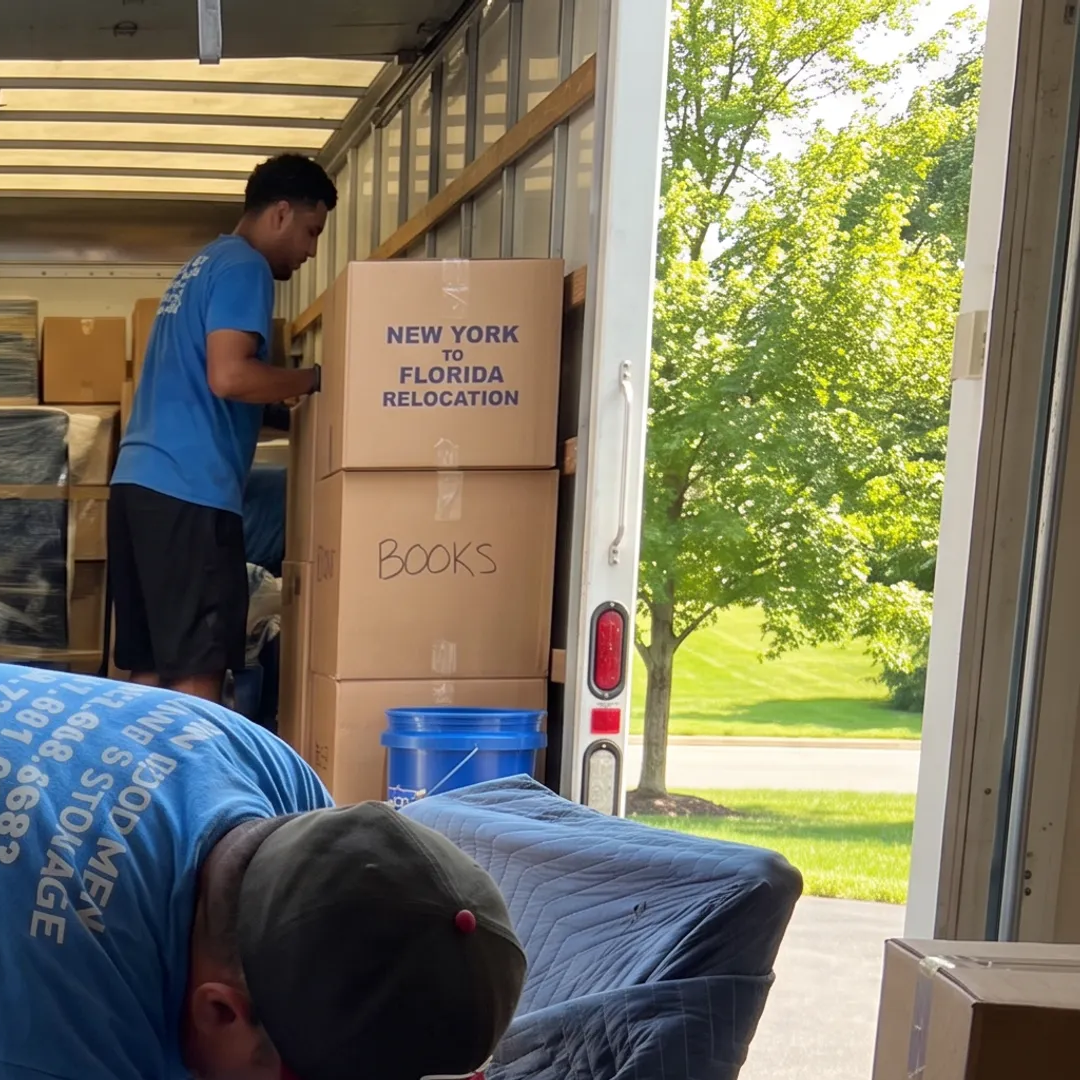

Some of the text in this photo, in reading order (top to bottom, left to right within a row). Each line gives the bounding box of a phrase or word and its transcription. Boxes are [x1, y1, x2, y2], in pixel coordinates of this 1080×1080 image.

[386, 325, 520, 344] NEW YORK
[442, 349, 464, 362] TO
[399, 366, 505, 384] FLORIDA
[382, 390, 520, 407] RELOCATION
[378, 538, 498, 580] BOOKS
